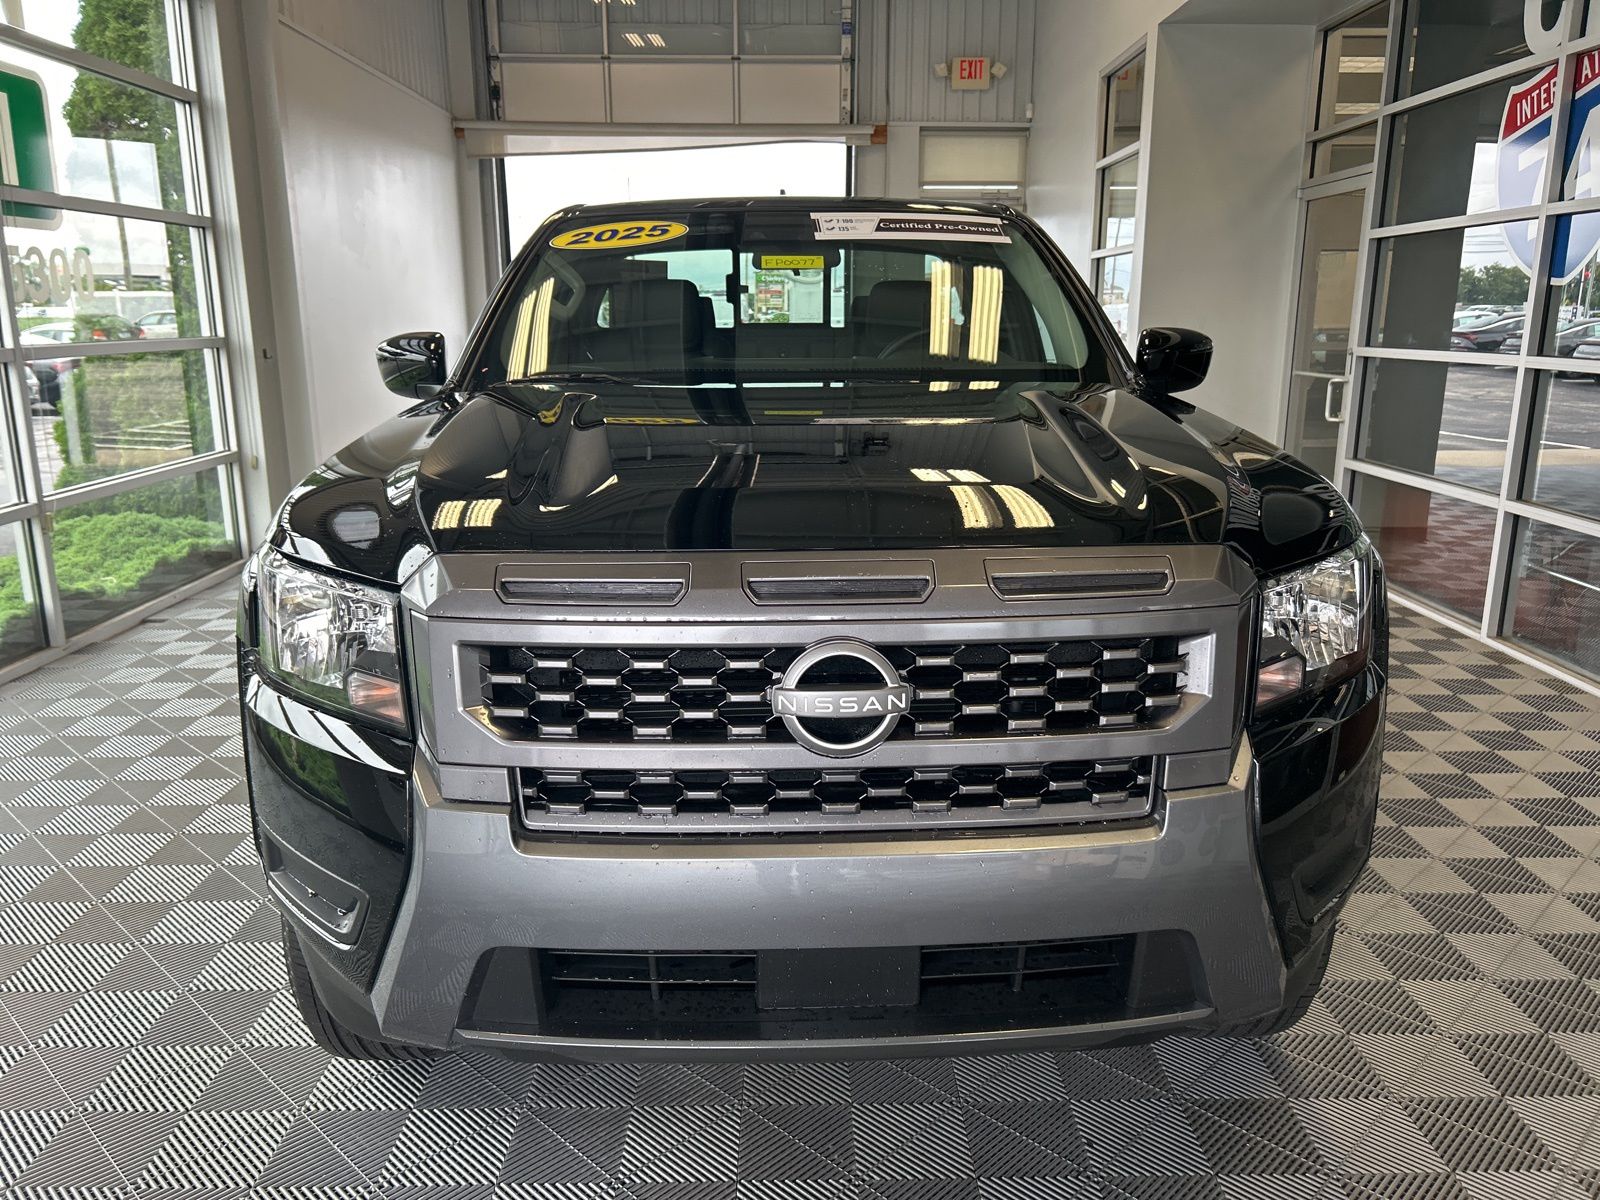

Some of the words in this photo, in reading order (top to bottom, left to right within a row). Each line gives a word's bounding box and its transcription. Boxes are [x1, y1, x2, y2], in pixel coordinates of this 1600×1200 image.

[959, 59, 985, 80] EXIT
[565, 224, 672, 246] 2025
[879, 222, 932, 230] Certified
[934, 223, 999, 233] Pre-Owned
[778, 692, 906, 713] NISSAN
